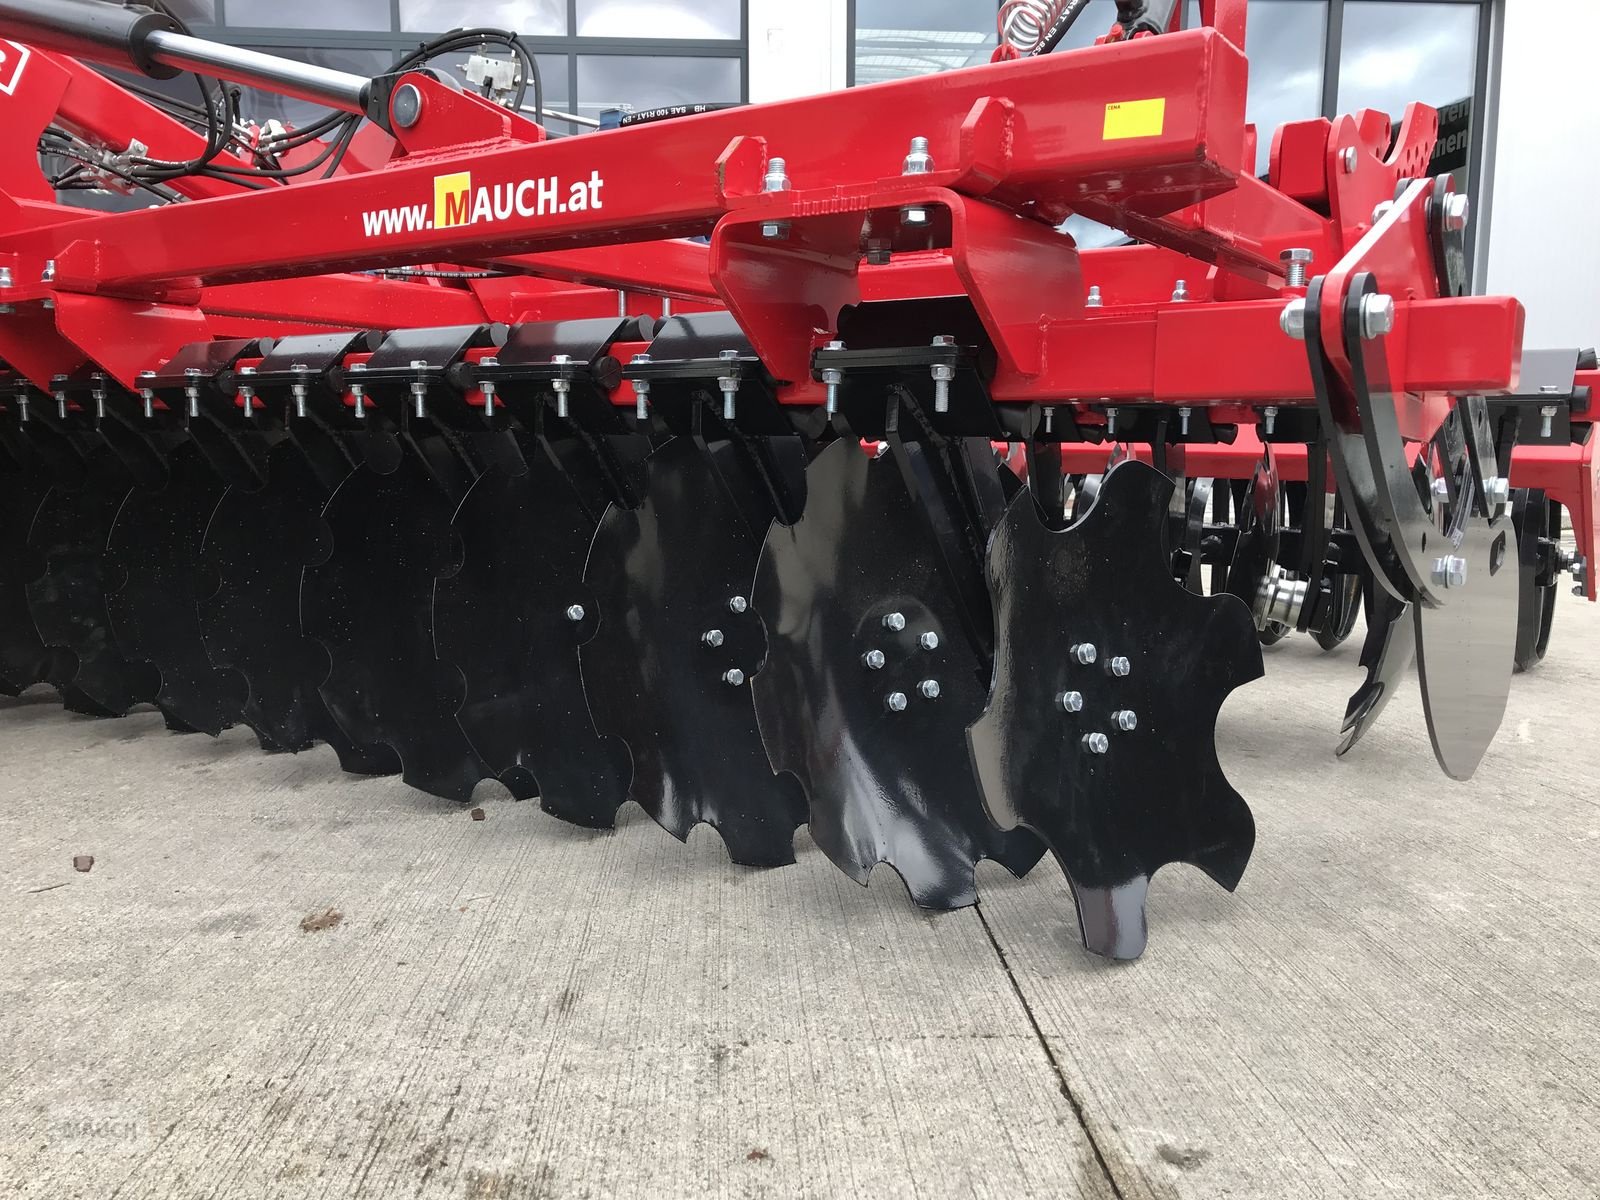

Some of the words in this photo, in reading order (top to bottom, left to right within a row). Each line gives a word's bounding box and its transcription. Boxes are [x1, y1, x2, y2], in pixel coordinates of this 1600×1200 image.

[1044, 27, 1057, 41] EN
[656, 108, 669, 117] 100
[670, 106, 687, 114] SAE
[694, 104, 706, 113] HB
[1438, 100, 1471, 126] ren
[362, 170, 604, 237] www.MAUCH.at
